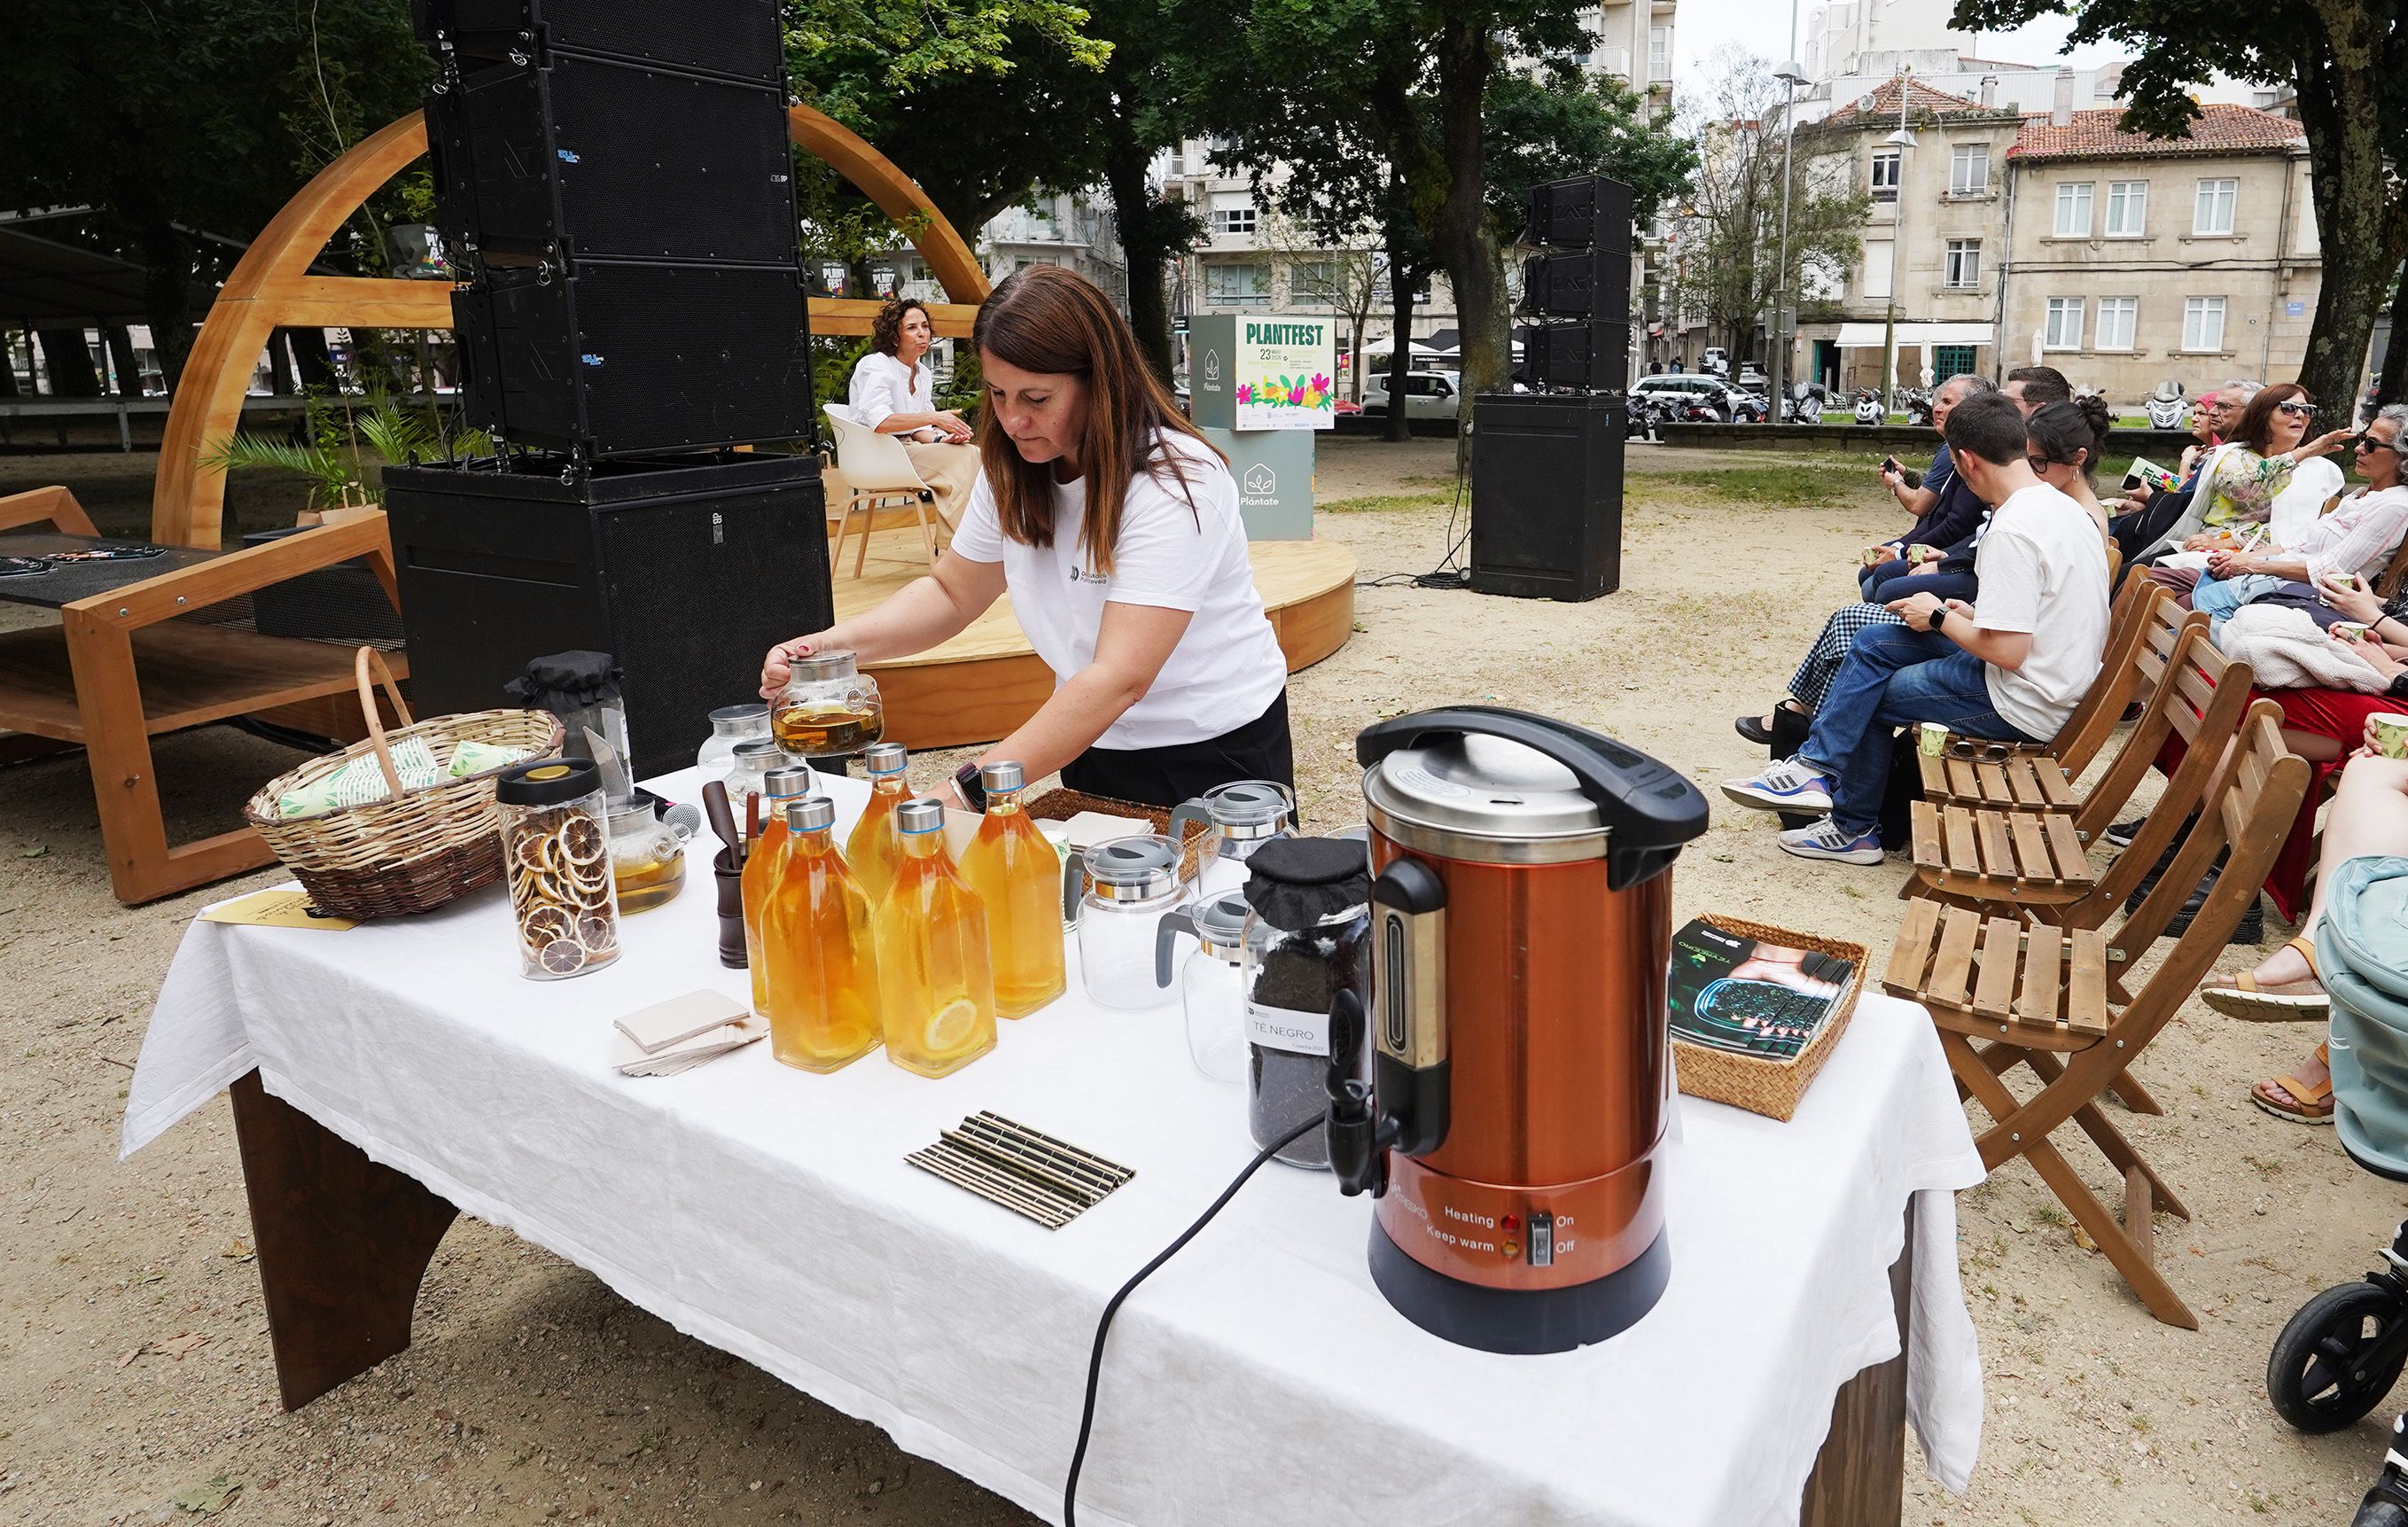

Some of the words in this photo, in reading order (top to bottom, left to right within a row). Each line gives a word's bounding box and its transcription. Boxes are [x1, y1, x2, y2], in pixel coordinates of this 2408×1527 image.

[1246, 323, 1323, 346] PLANTFEST
[1260, 348, 1271, 360] 23
[1241, 496, 1279, 505] Plántate
[1253, 1021, 1267, 1033] TÉ
[1269, 1025, 1314, 1040] NEGRO
[1445, 1205, 1494, 1229] Heating
[1556, 1215, 1574, 1227] On
[1426, 1224, 1456, 1244] Keep
[1460, 1236, 1494, 1252] warm
[1556, 1240, 1575, 1253] Off
